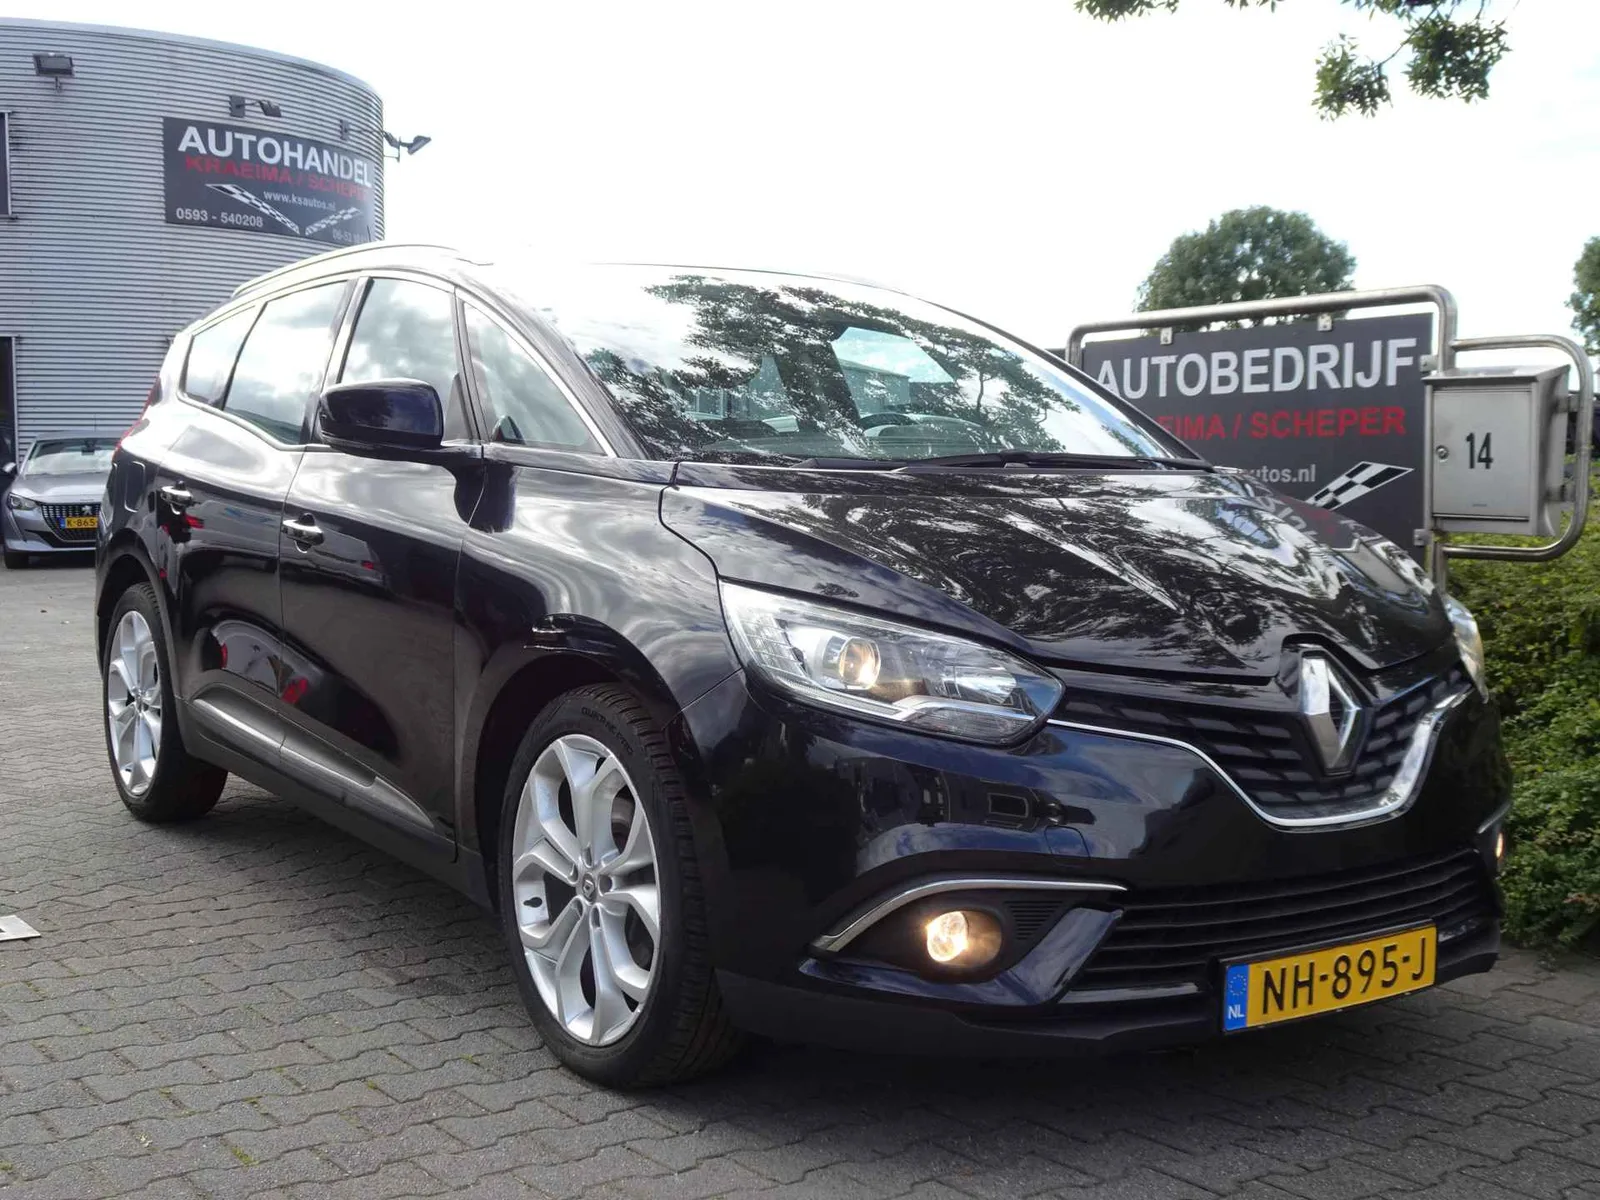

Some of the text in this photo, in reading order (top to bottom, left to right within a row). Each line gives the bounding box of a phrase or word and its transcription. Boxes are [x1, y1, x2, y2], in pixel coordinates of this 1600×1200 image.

[178, 126, 372, 188] AUTOHANDEL
[176, 207, 208, 221] 0593
[220, 211, 263, 227] 540208
[1098, 338, 1417, 399] AUTOBEDRIJF
[1251, 405, 1406, 438] SCHEPER
[1466, 432, 1493, 469] 14
[1228, 937, 1426, 1020] NL NH-895-J
